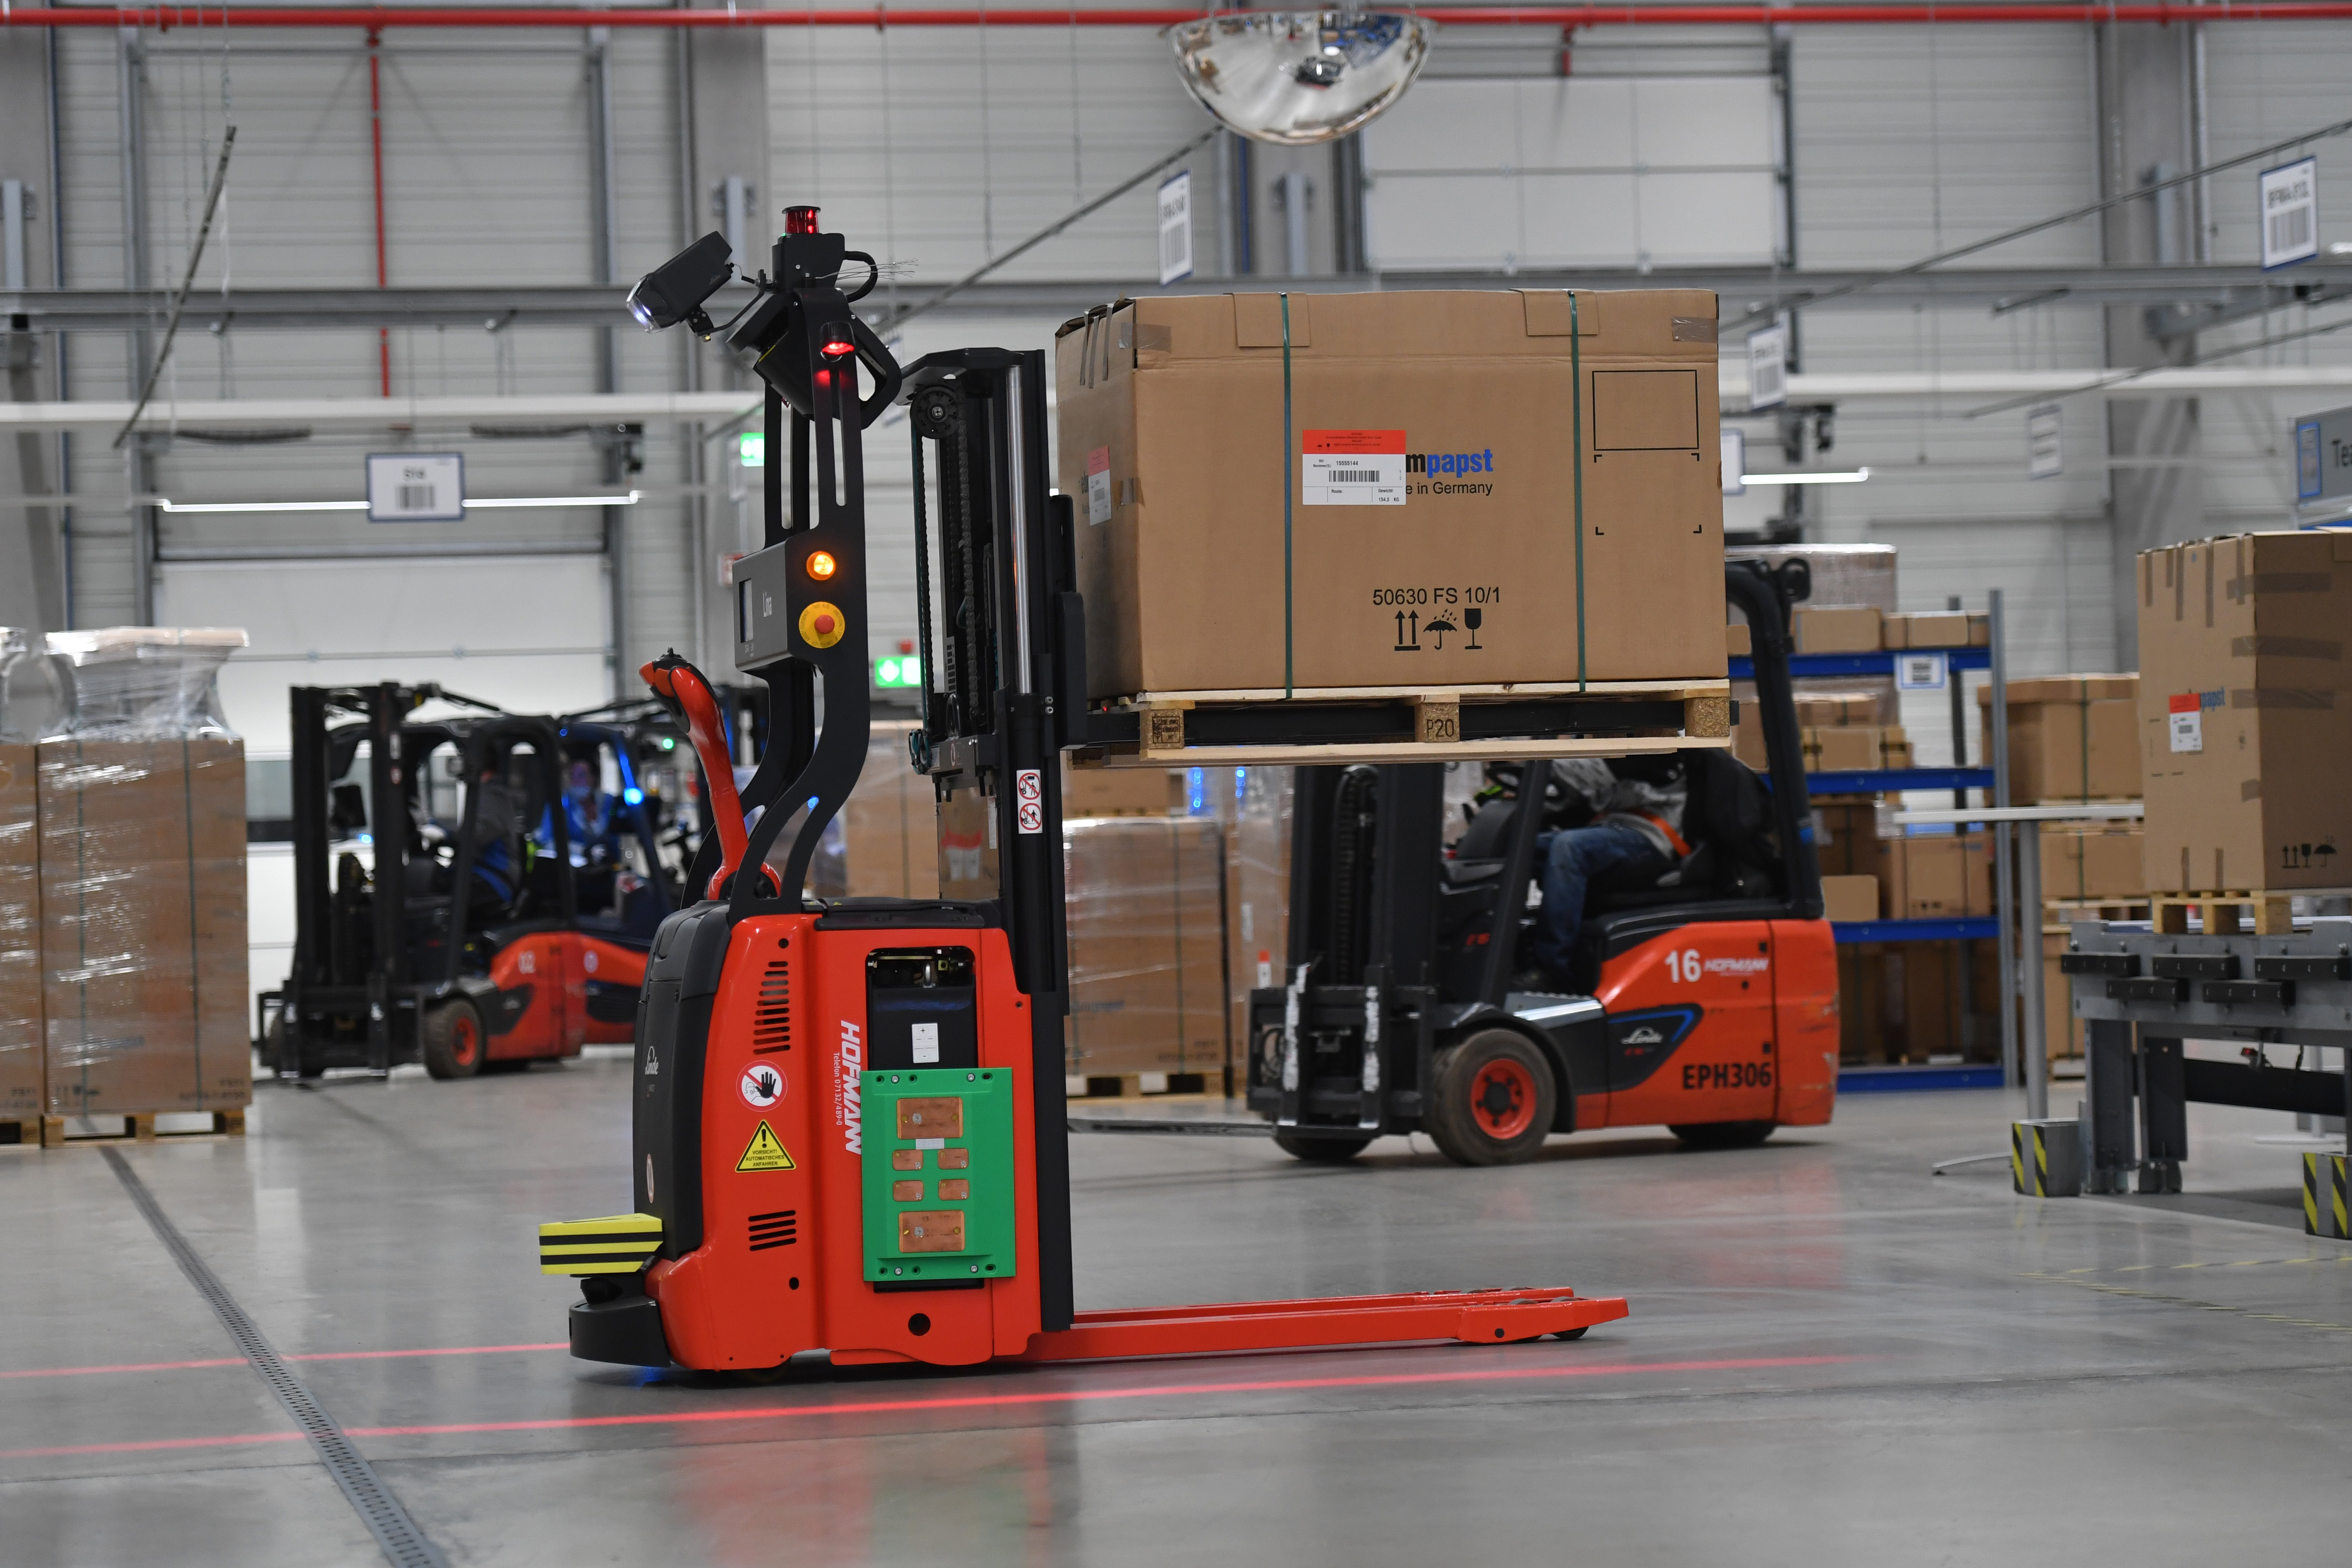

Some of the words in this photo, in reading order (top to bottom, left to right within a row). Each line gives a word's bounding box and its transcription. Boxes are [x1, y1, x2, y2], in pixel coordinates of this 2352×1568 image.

[1406, 449, 1493, 479] mpapst
[2332, 438, 2352, 469] Te
[1417, 482, 1428, 494] in
[1433, 482, 1493, 496] Germany
[1373, 588, 1427, 605] 50630
[1434, 587, 1458, 604] FS
[1465, 586, 1500, 604] 10/1
[1426, 719, 1454, 738] P20
[1664, 948, 1702, 983] 16
[841, 1020, 862, 1155] HOFMANN
[1682, 1062, 1772, 1090] EPH306
[834, 1079, 843, 1126] 07132/489-0
